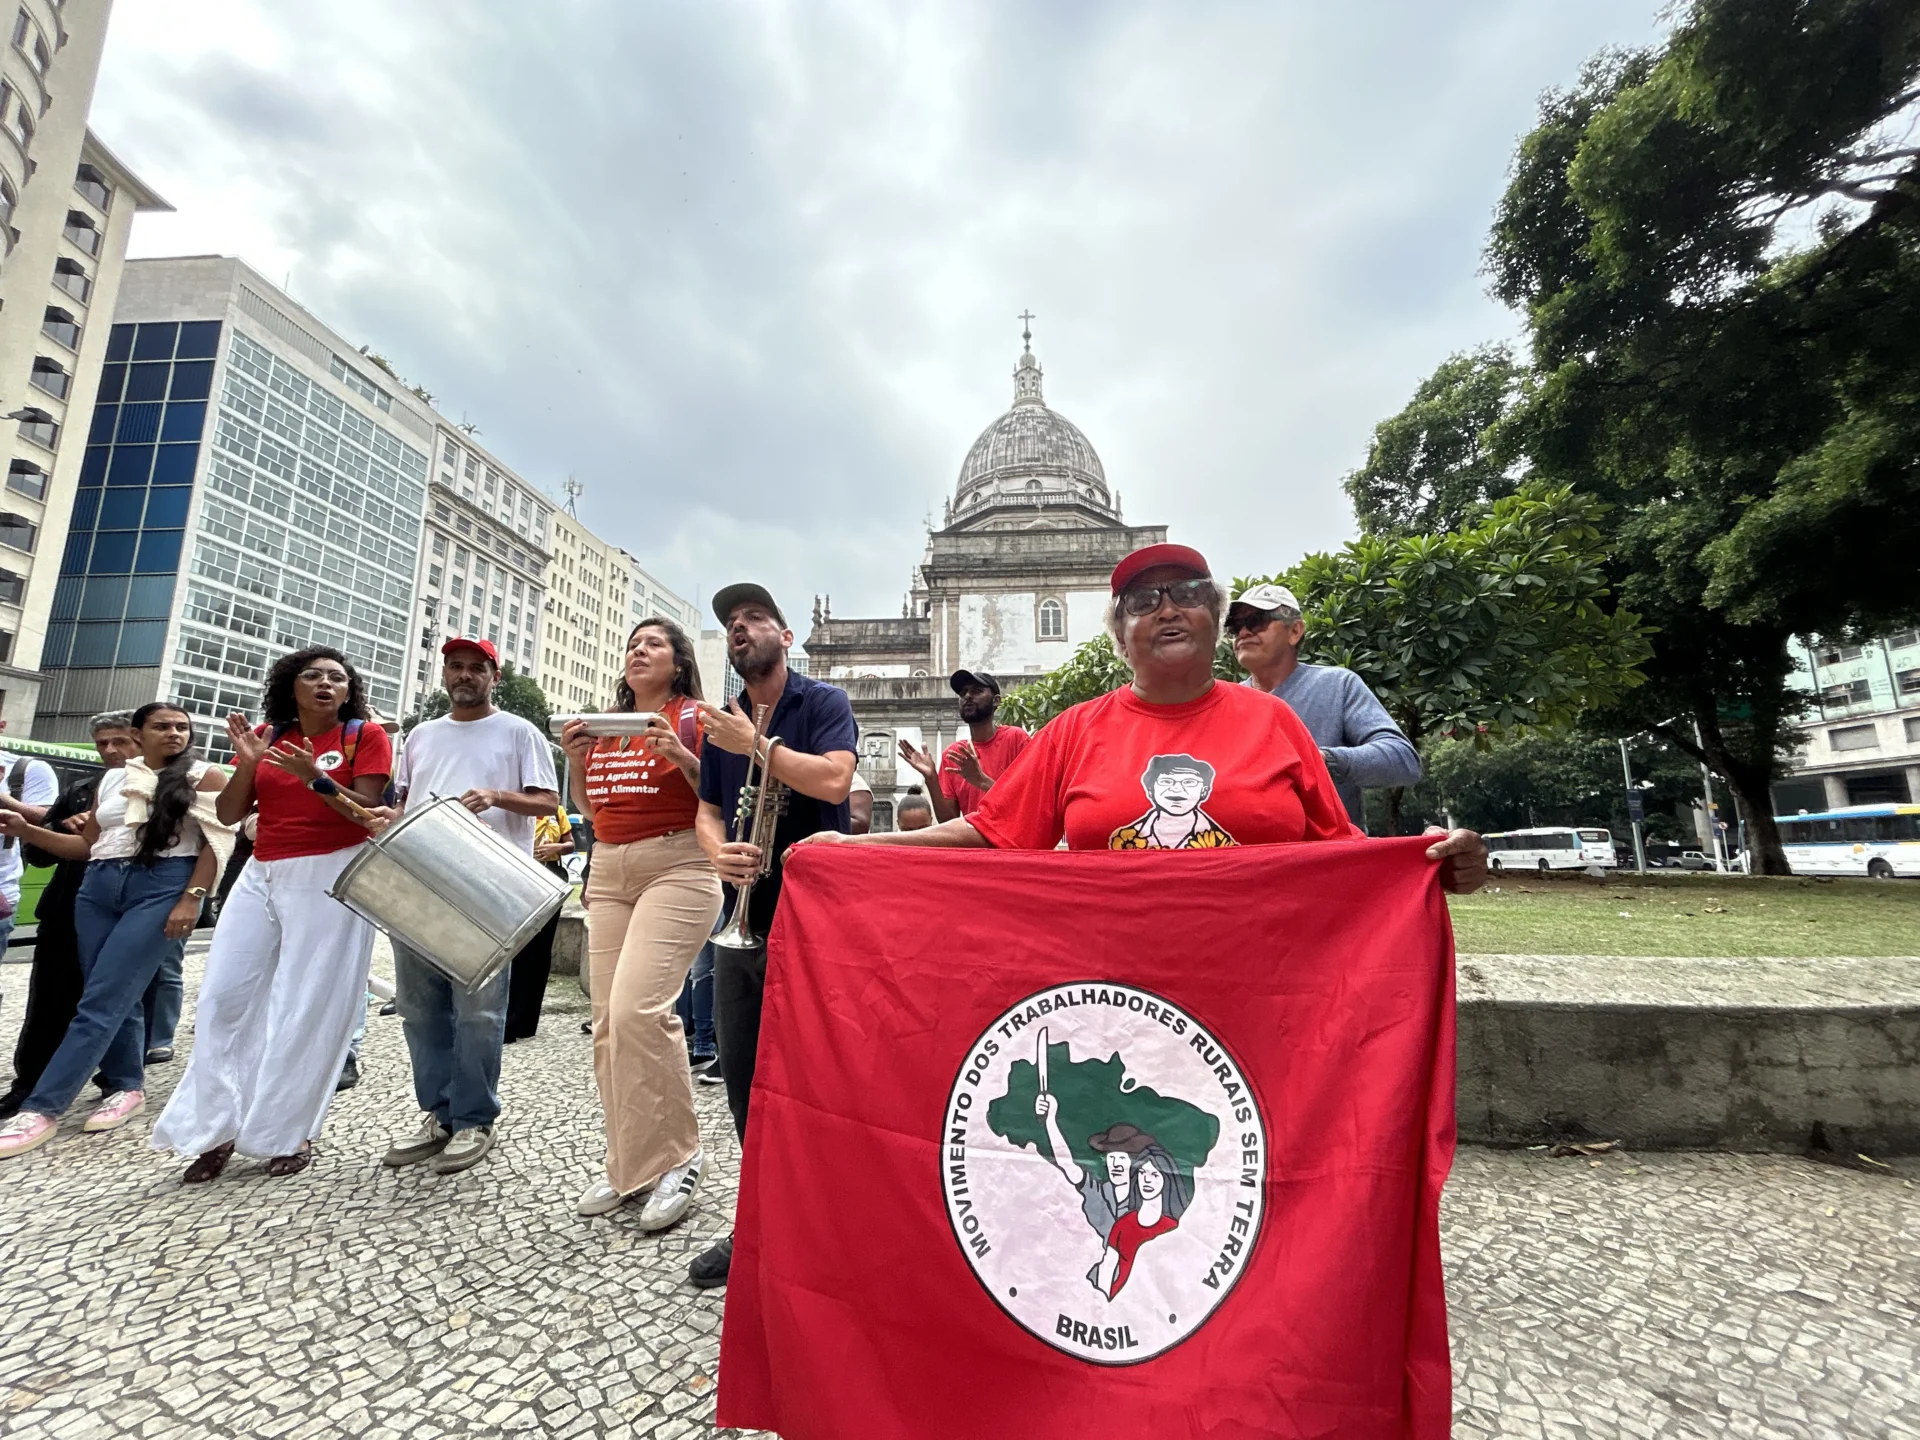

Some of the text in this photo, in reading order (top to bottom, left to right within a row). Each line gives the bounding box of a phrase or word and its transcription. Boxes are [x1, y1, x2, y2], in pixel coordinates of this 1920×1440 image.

[605, 760, 646, 768] Climática
[648, 759, 655, 767] &
[606, 771, 639, 782] Agrária
[641, 771, 649, 780] &
[611, 784, 659, 793] Alimentar
[950, 988, 1258, 1290] MOVIMENTO DOS TRABALHADORES RURAIS SEM TERRA
[1055, 1314, 1139, 1350] BRASIL
